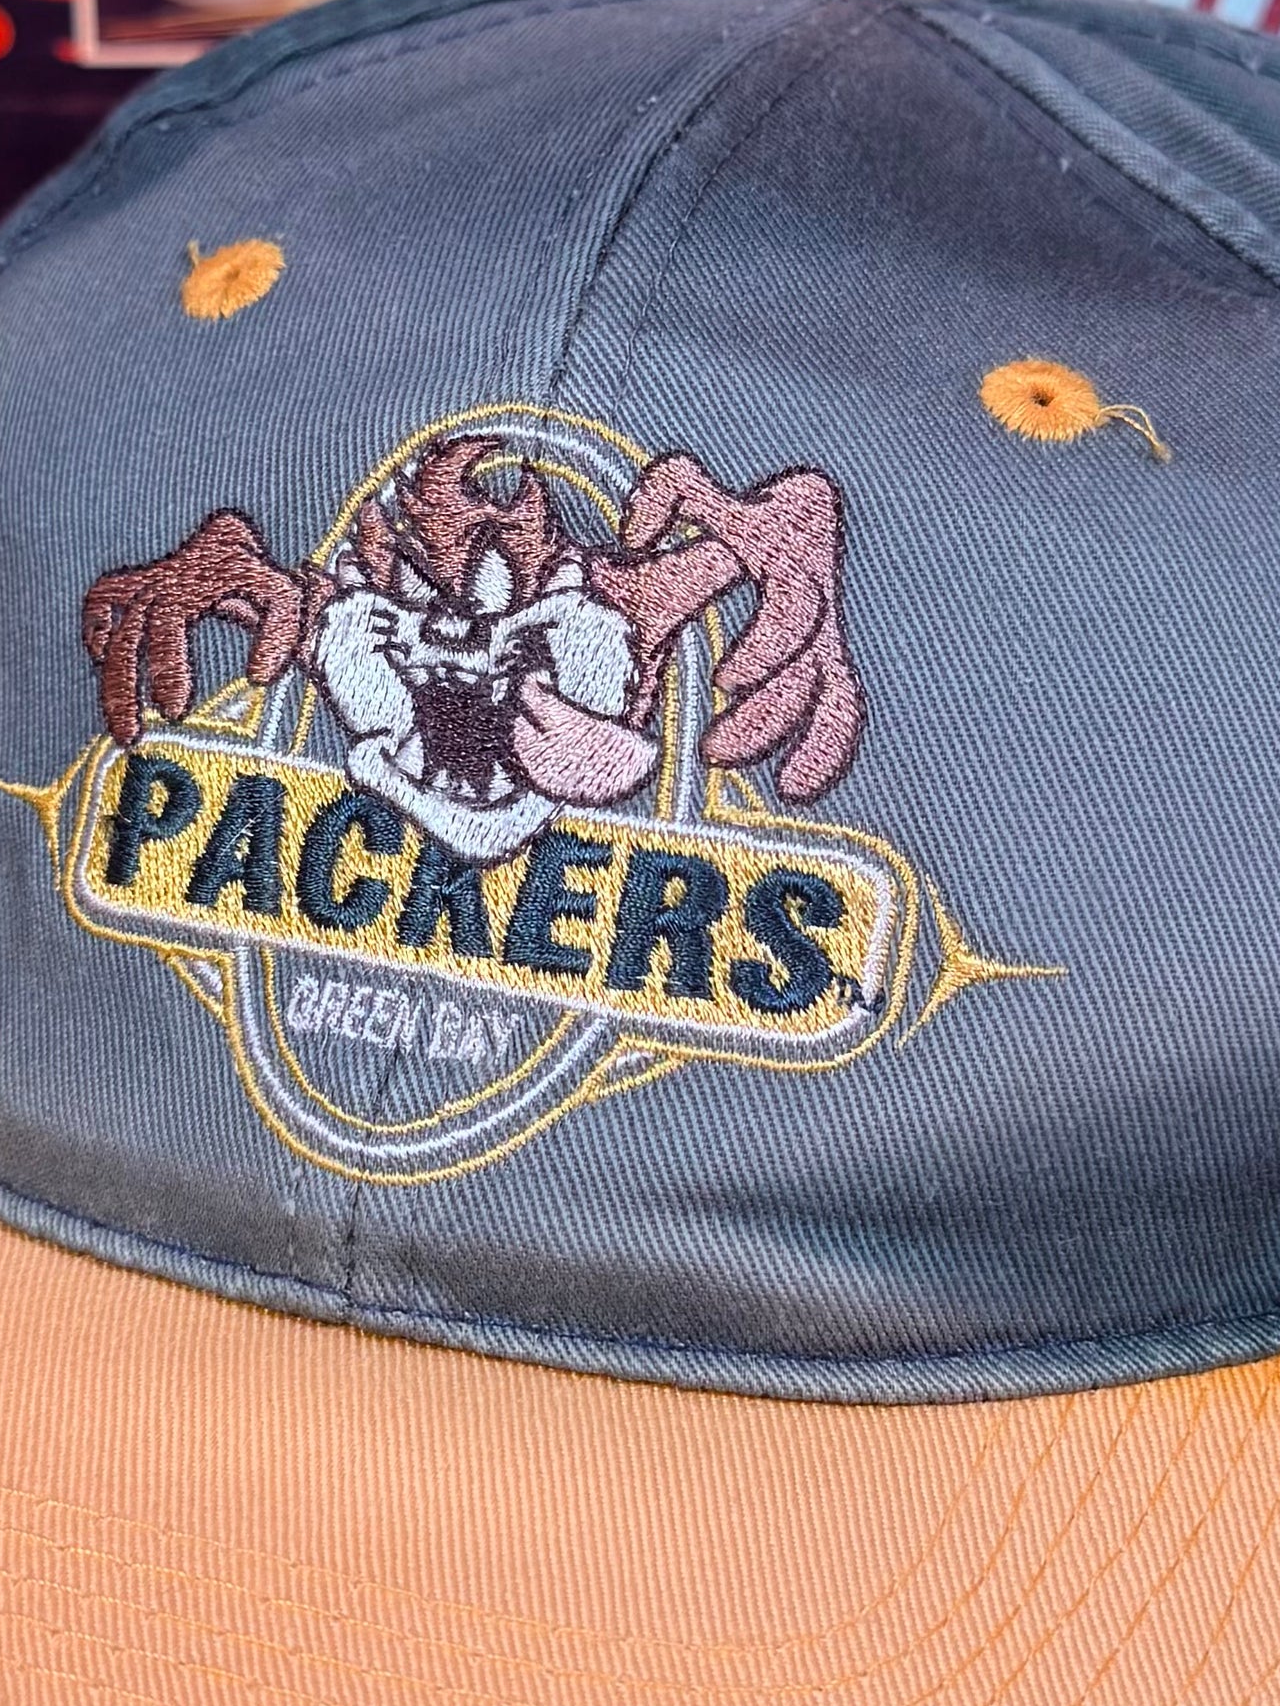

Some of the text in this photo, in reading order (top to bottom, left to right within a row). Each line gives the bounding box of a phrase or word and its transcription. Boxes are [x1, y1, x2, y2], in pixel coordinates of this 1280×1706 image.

[102, 751, 848, 1015] PACKERS
[287, 973, 522, 1065] GREEN BAY
